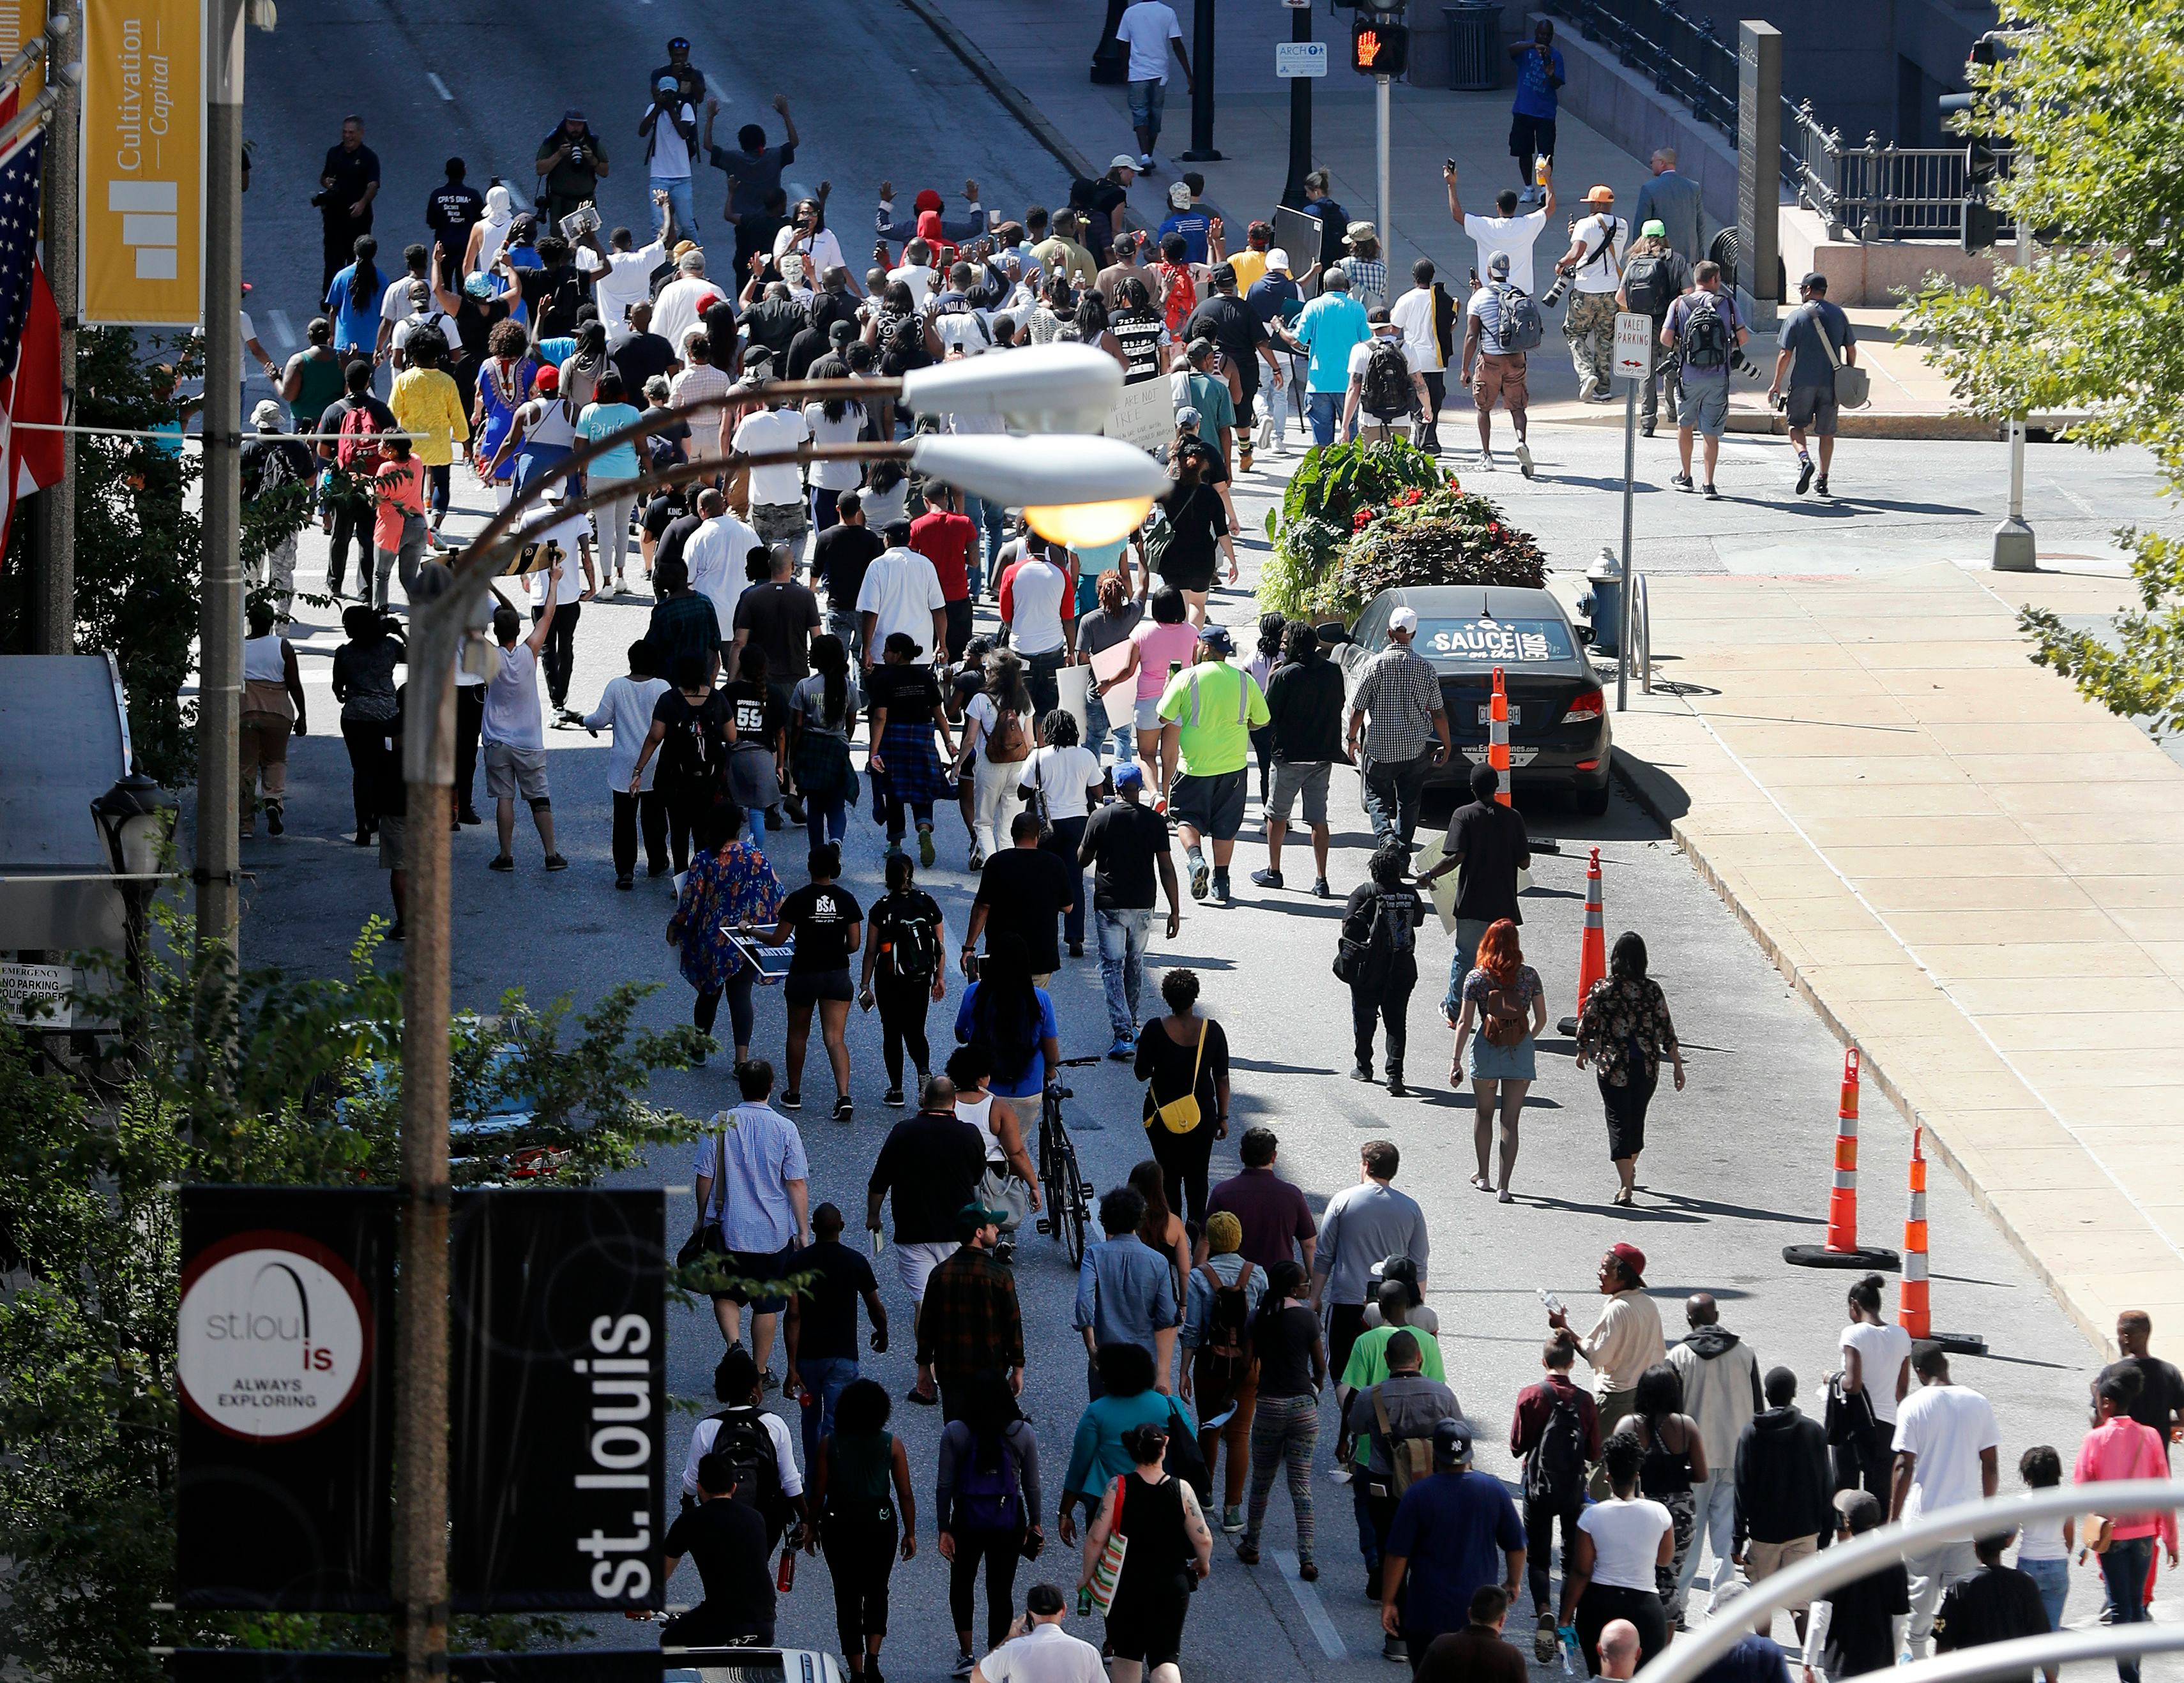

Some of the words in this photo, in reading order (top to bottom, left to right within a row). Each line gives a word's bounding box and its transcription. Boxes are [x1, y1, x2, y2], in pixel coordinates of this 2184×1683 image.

[1280, 46, 1307, 55] ARCH
[116, 19, 141, 170] Cultivation
[148, 54, 174, 135] Capital
[1623, 318, 1644, 331] VALET
[1618, 332, 1649, 346] PARKING
[1125, 394, 1139, 407] ARE
[1142, 388, 1159, 403] NOT
[1115, 407, 1142, 428] FREE
[1434, 631, 1515, 651] SAUCE
[1521, 633, 1549, 660] SIDE
[1469, 650, 1489, 658] on
[1490, 647, 1516, 659] the
[816, 898, 837, 912] BSA
[755, 946, 795, 956] MATTER
[2, 967, 60, 977] EMERGENCY
[3, 977, 15, 988] NO
[17, 979, 59, 990] PARKING
[233, 1378, 302, 1392] ALWAYS
[218, 1394, 317, 1408] EXPLORING
[573, 1313, 651, 1490] louis
[576, 1510, 651, 1599] st.
